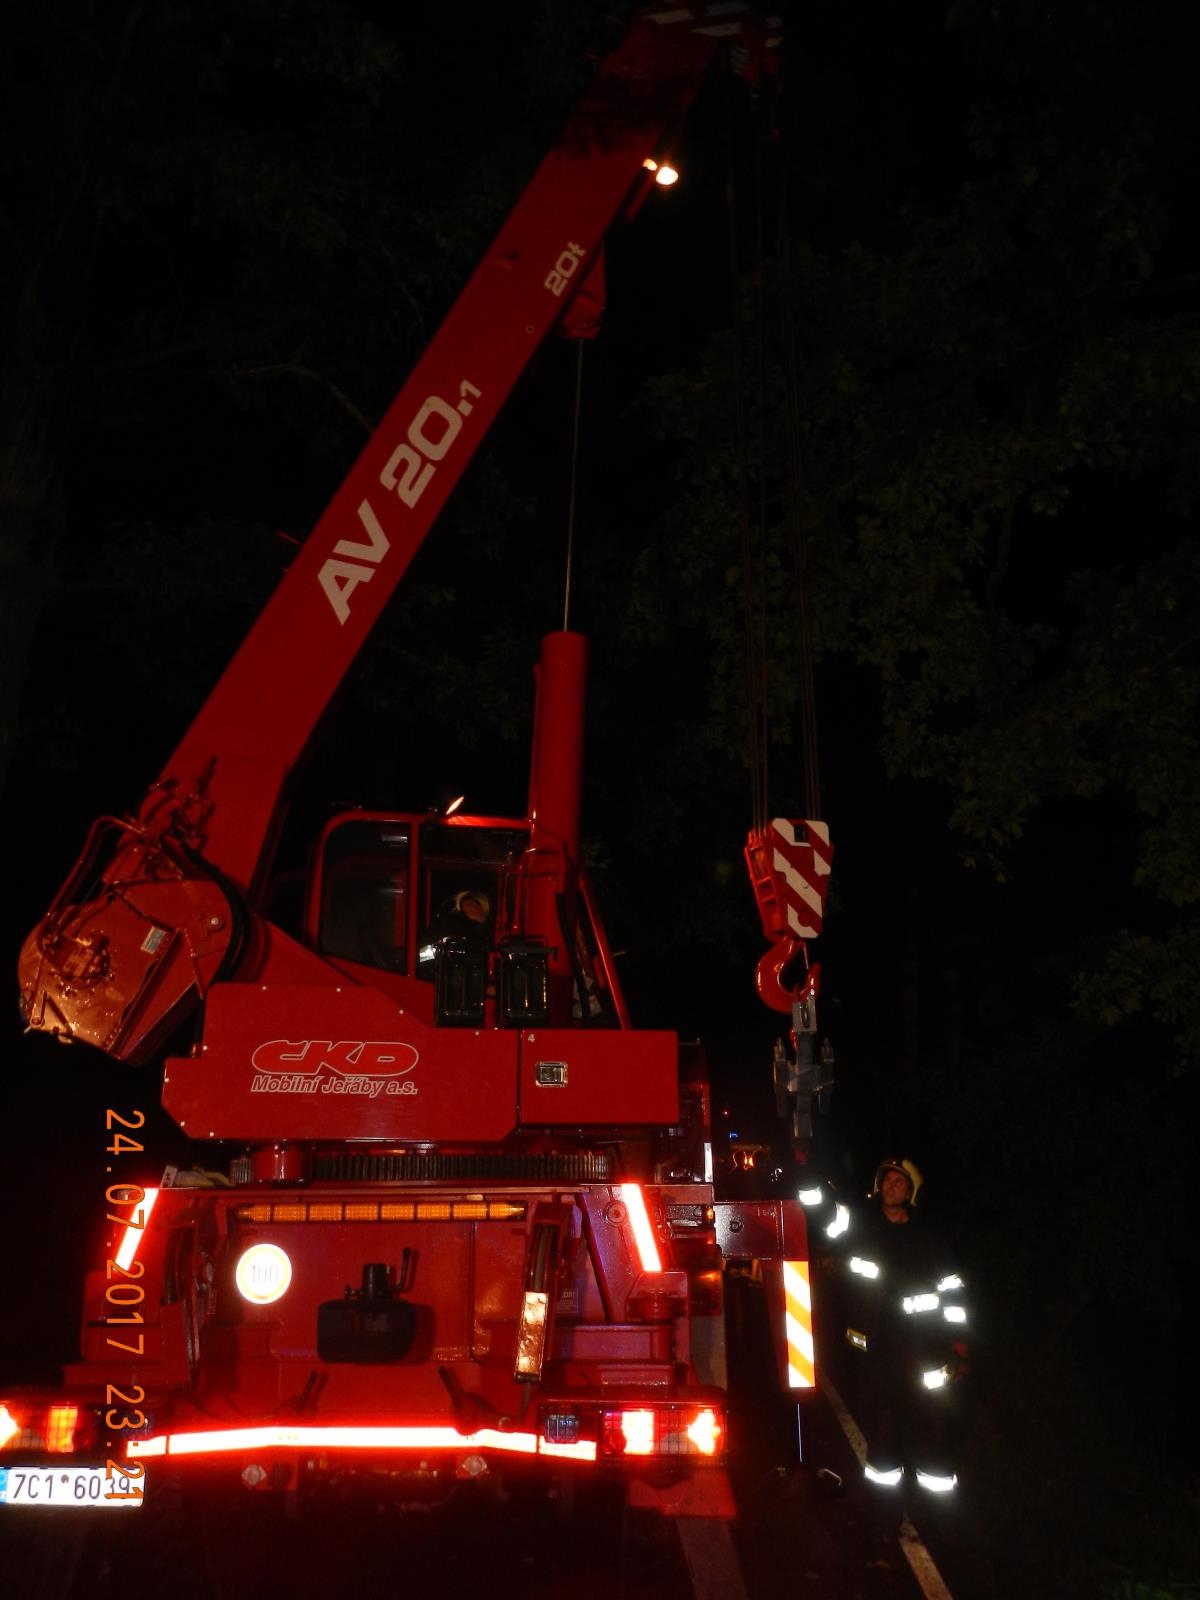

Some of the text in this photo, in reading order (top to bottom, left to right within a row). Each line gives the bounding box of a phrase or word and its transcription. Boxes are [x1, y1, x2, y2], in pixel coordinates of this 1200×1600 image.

[543, 241, 586, 297] 20t
[317, 379, 482, 626] AV 20.1
[250, 1075, 418, 1098] Mobilní Jeřáby a.s.
[252, 1264, 279, 1284] 100
[13, 1474, 54, 1499] 7C1
